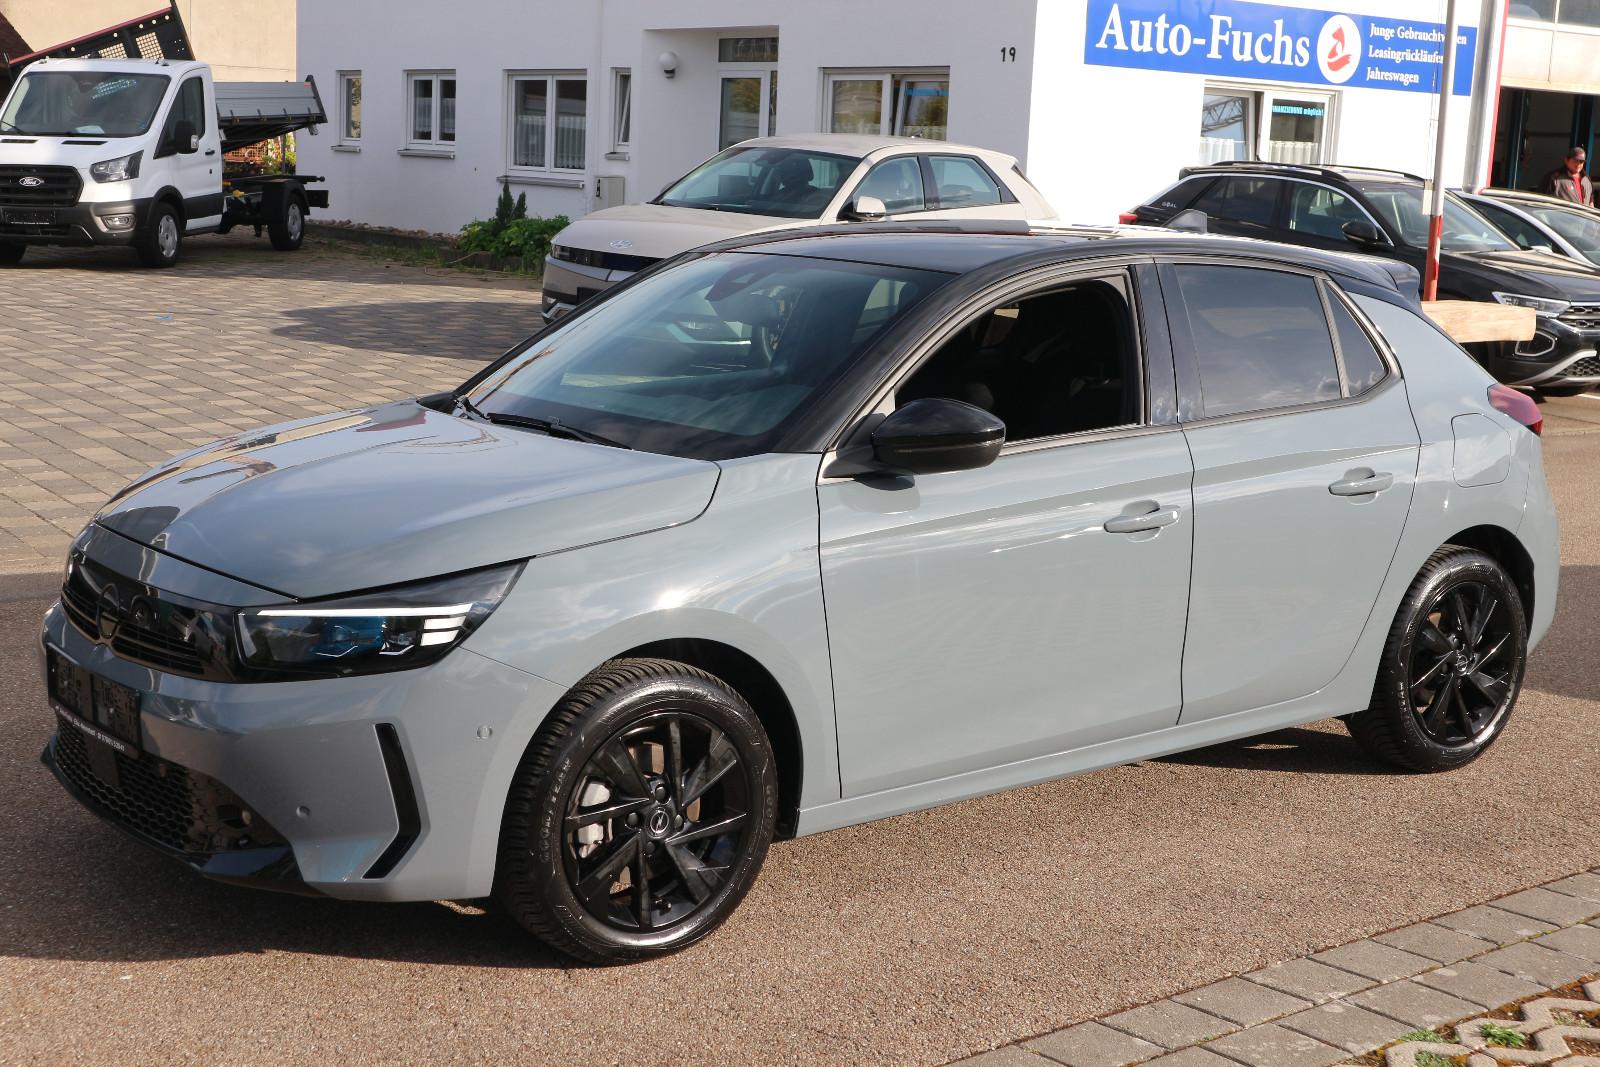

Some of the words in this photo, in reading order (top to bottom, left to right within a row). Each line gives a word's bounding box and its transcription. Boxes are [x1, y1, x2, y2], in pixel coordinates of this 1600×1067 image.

[1096, 3, 1310, 67] Auto-Fuchs
[1370, 23, 1395, 41] Junge
[1397, 26, 1467, 45] Gebrauchtwen
[1001, 47, 1016, 62] 19
[1367, 67, 1419, 86] Jahreswagen
